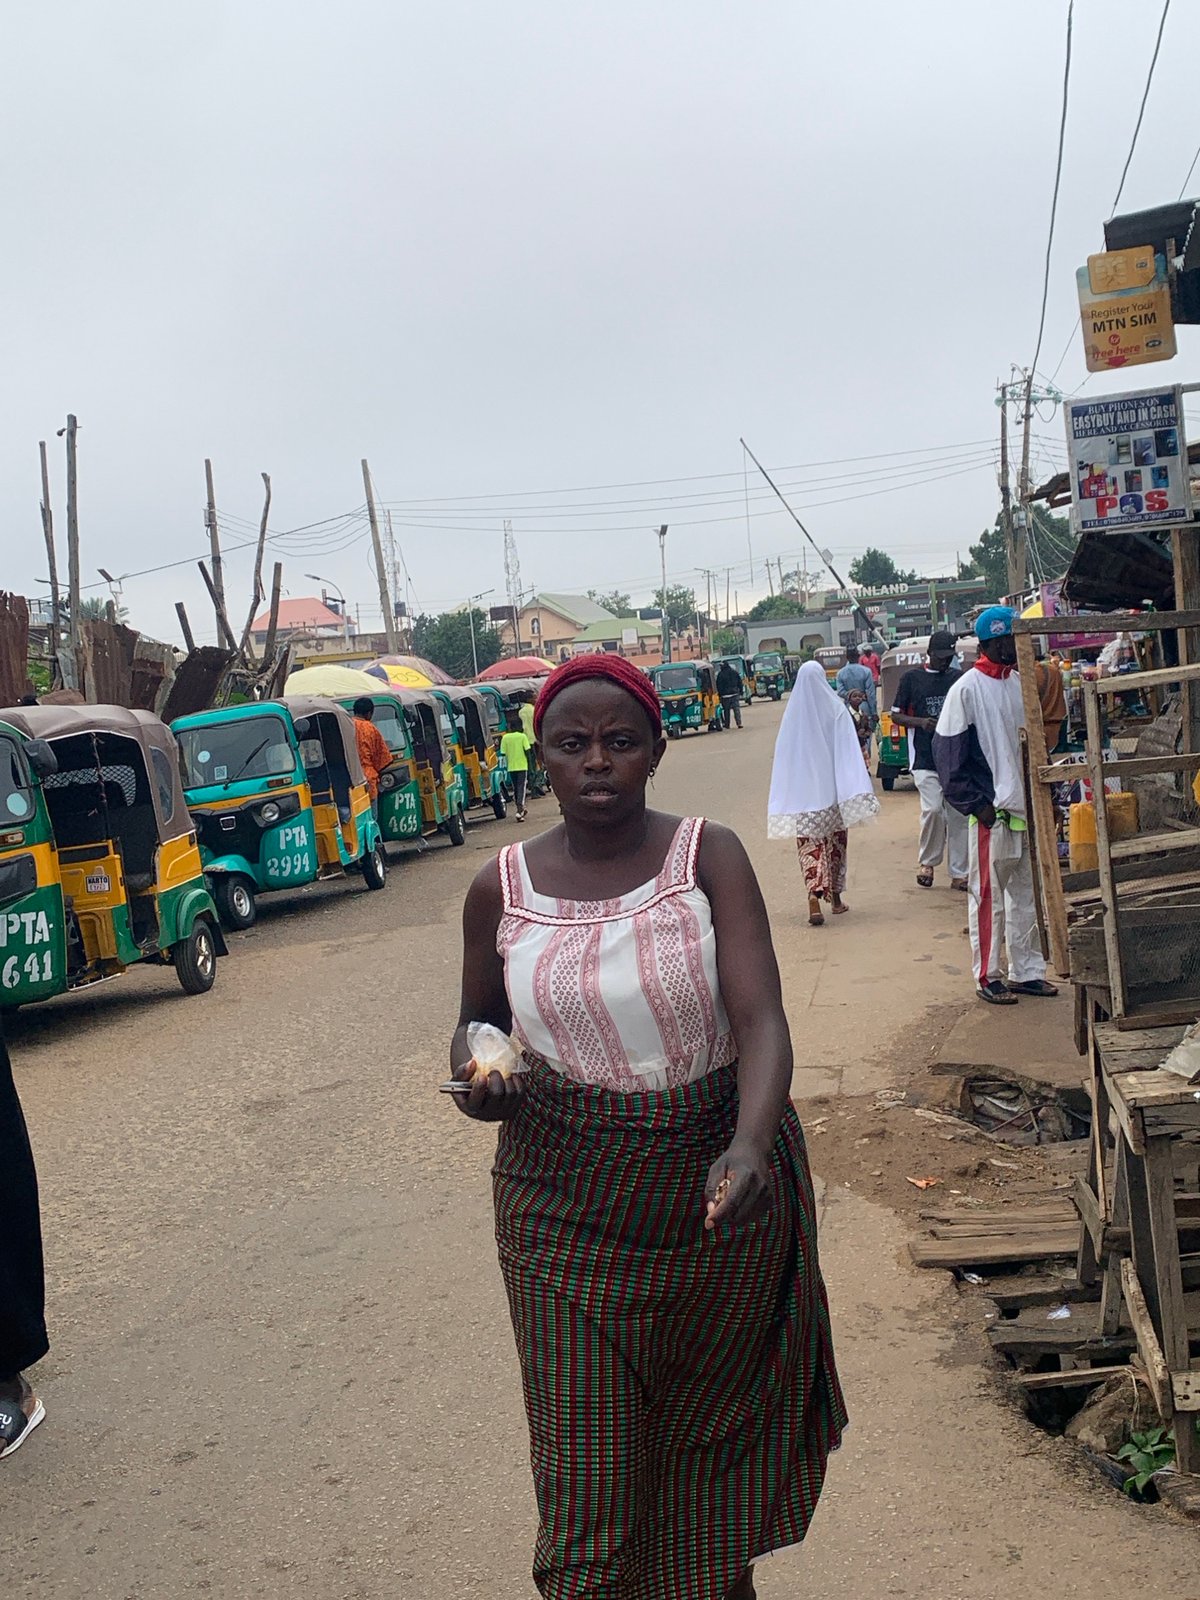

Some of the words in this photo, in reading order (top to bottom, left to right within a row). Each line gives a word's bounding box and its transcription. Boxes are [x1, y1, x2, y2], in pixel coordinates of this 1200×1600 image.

[1091, 306, 1130, 319] Register
[1132, 302, 1153, 311] Your
[1093, 317, 1126, 333] MTN
[1130, 312, 1157, 327] SIM
[1116, 345, 1141, 355] here
[1088, 404, 1107, 415] BUY
[1108, 400, 1145, 412] PHONES
[1146, 397, 1160, 407] ON
[1073, 412, 1115, 431] EASYBUY
[1117, 409, 1136, 424] AND
[1138, 407, 1149, 421] IN
[1150, 404, 1176, 420] CASH
[1075, 428, 1099, 438] HERE
[1100, 425, 1117, 435] AND
[1119, 418, 1177, 432] ACCESSORIES
[1096, 490, 1169, 518] POS
[395, 792, 416, 810] PTA
[388, 814, 418, 833] 4655
